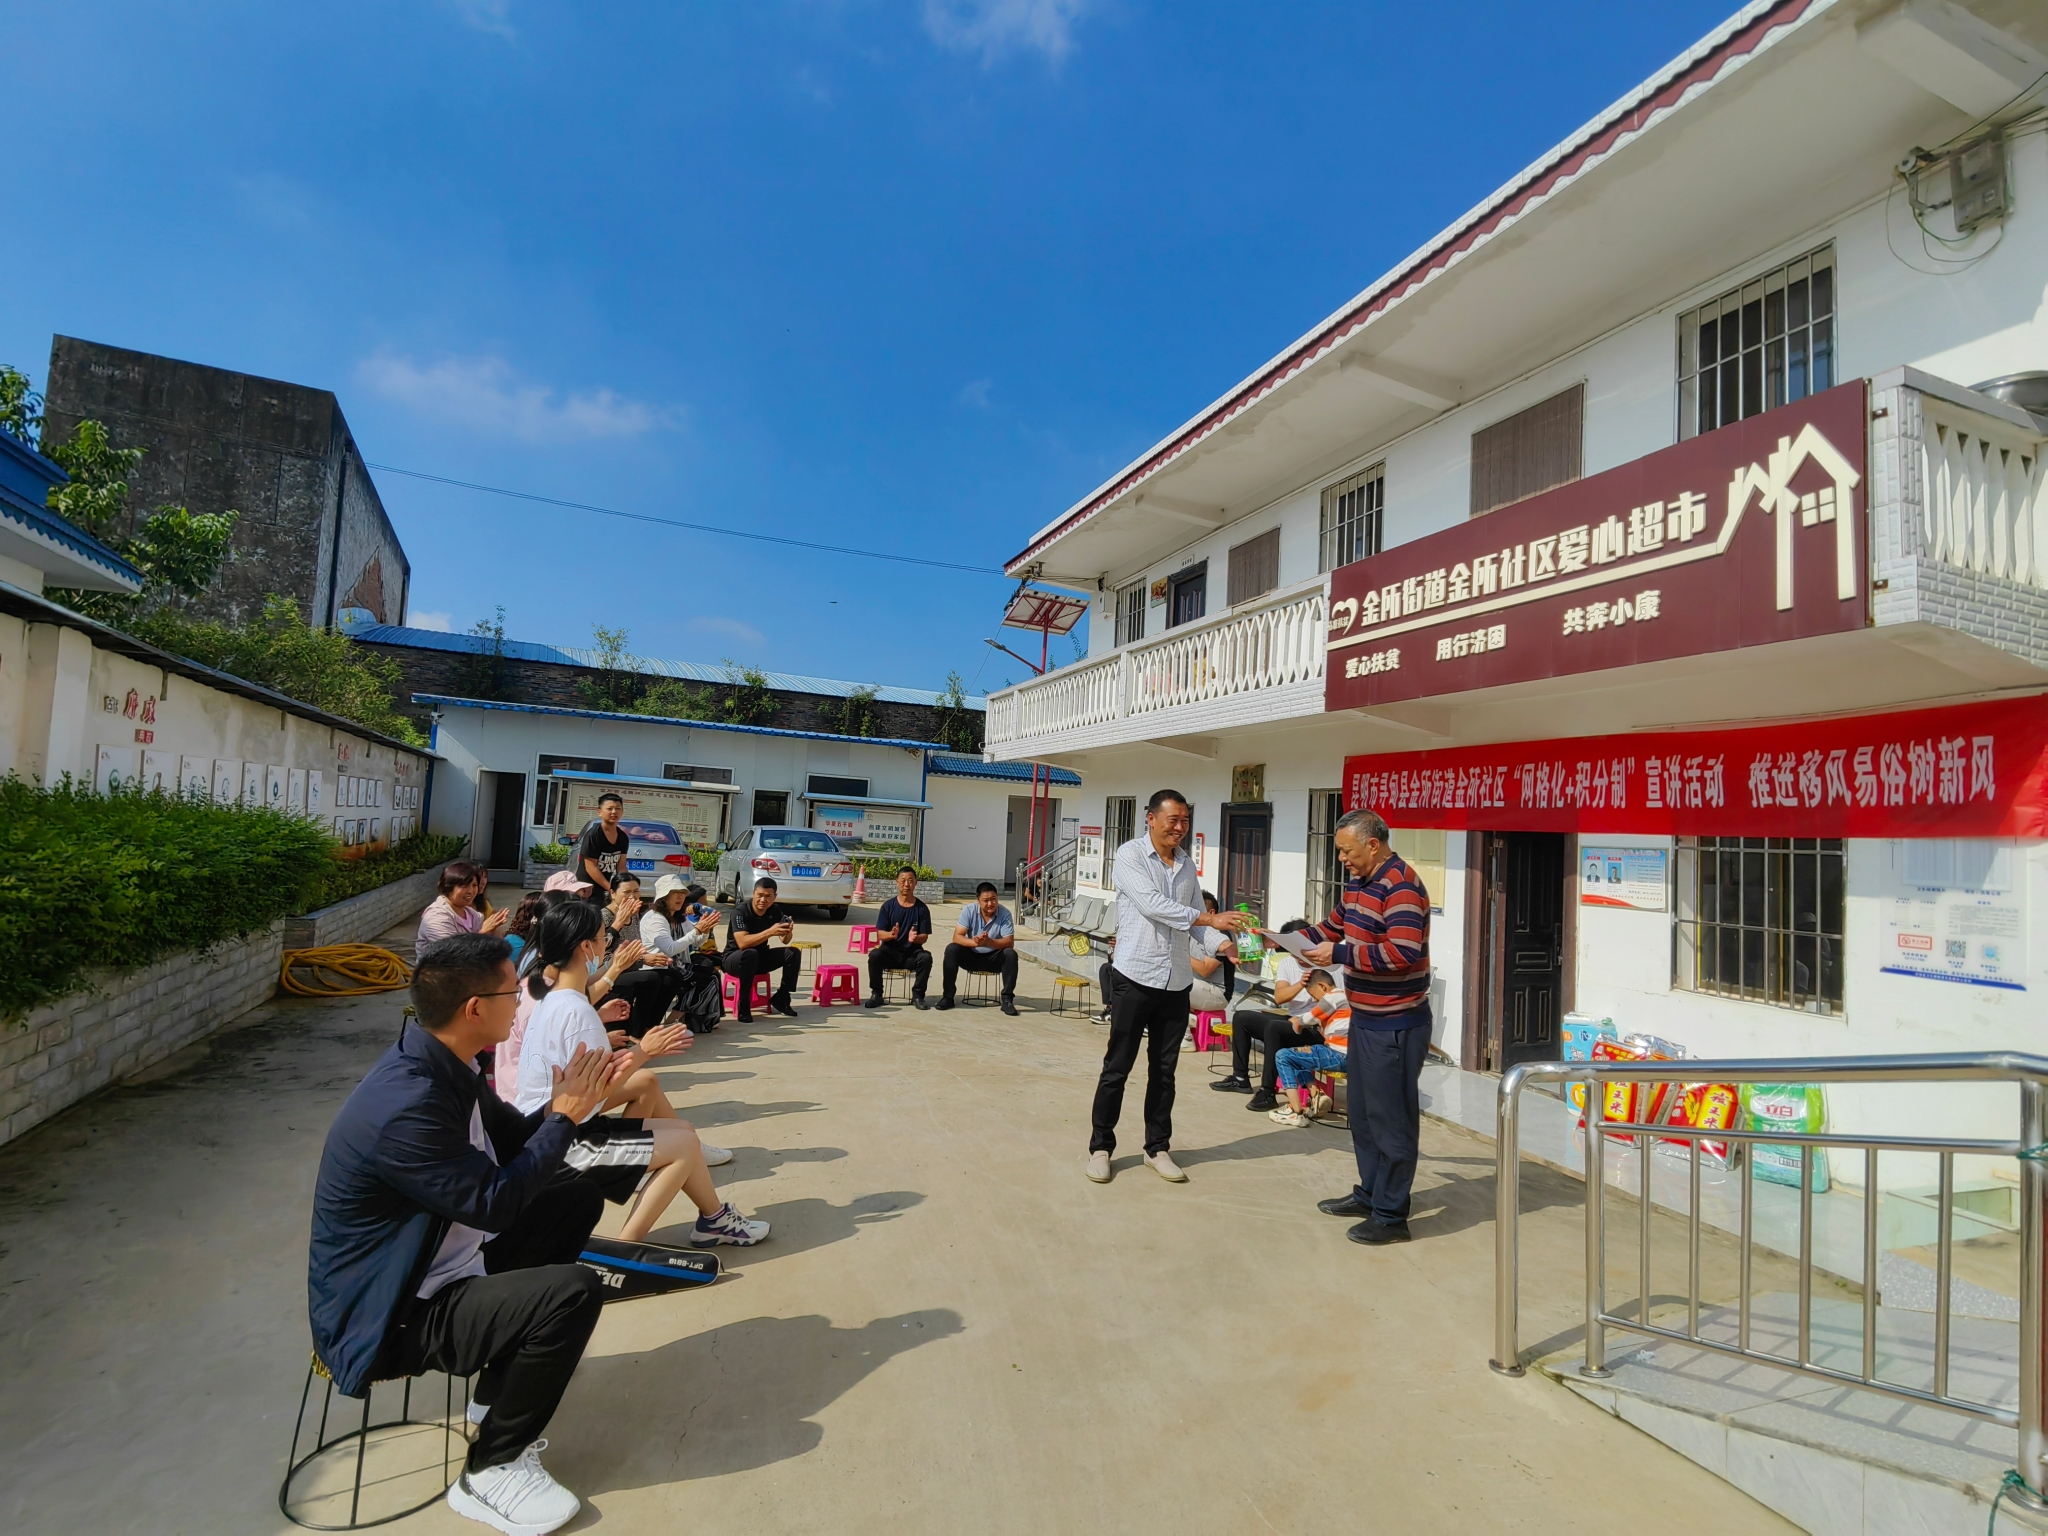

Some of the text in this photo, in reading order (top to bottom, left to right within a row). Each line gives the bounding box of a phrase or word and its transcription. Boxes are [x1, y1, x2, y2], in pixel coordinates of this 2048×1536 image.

[1361, 490, 1707, 627] 金所街道金所社区爱心超市
[1562, 590, 1661, 636] 共奔小康
[1436, 624, 1507, 661] 用行济困
[1345, 648, 1401, 679] 爱心扶贫
[1748, 735, 1996, 808] 推进移风易俗树新风
[1763, 1104, 1793, 1117] 立白
